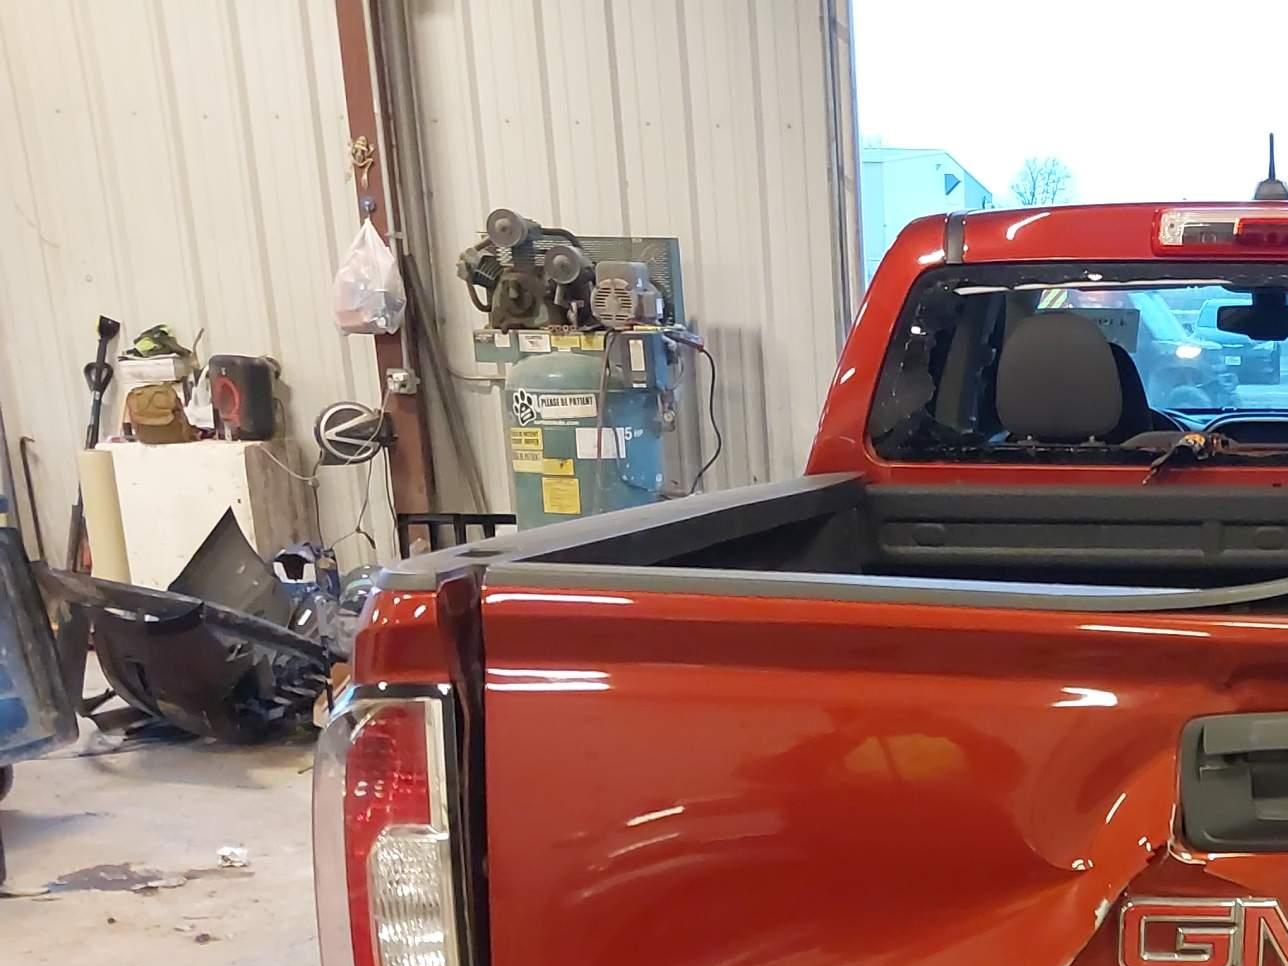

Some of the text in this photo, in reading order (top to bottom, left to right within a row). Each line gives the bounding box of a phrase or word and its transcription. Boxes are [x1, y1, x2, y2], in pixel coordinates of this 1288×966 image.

[541, 396, 593, 407] PLEASE BE PATIENT
[624, 427, 633, 440] 5
